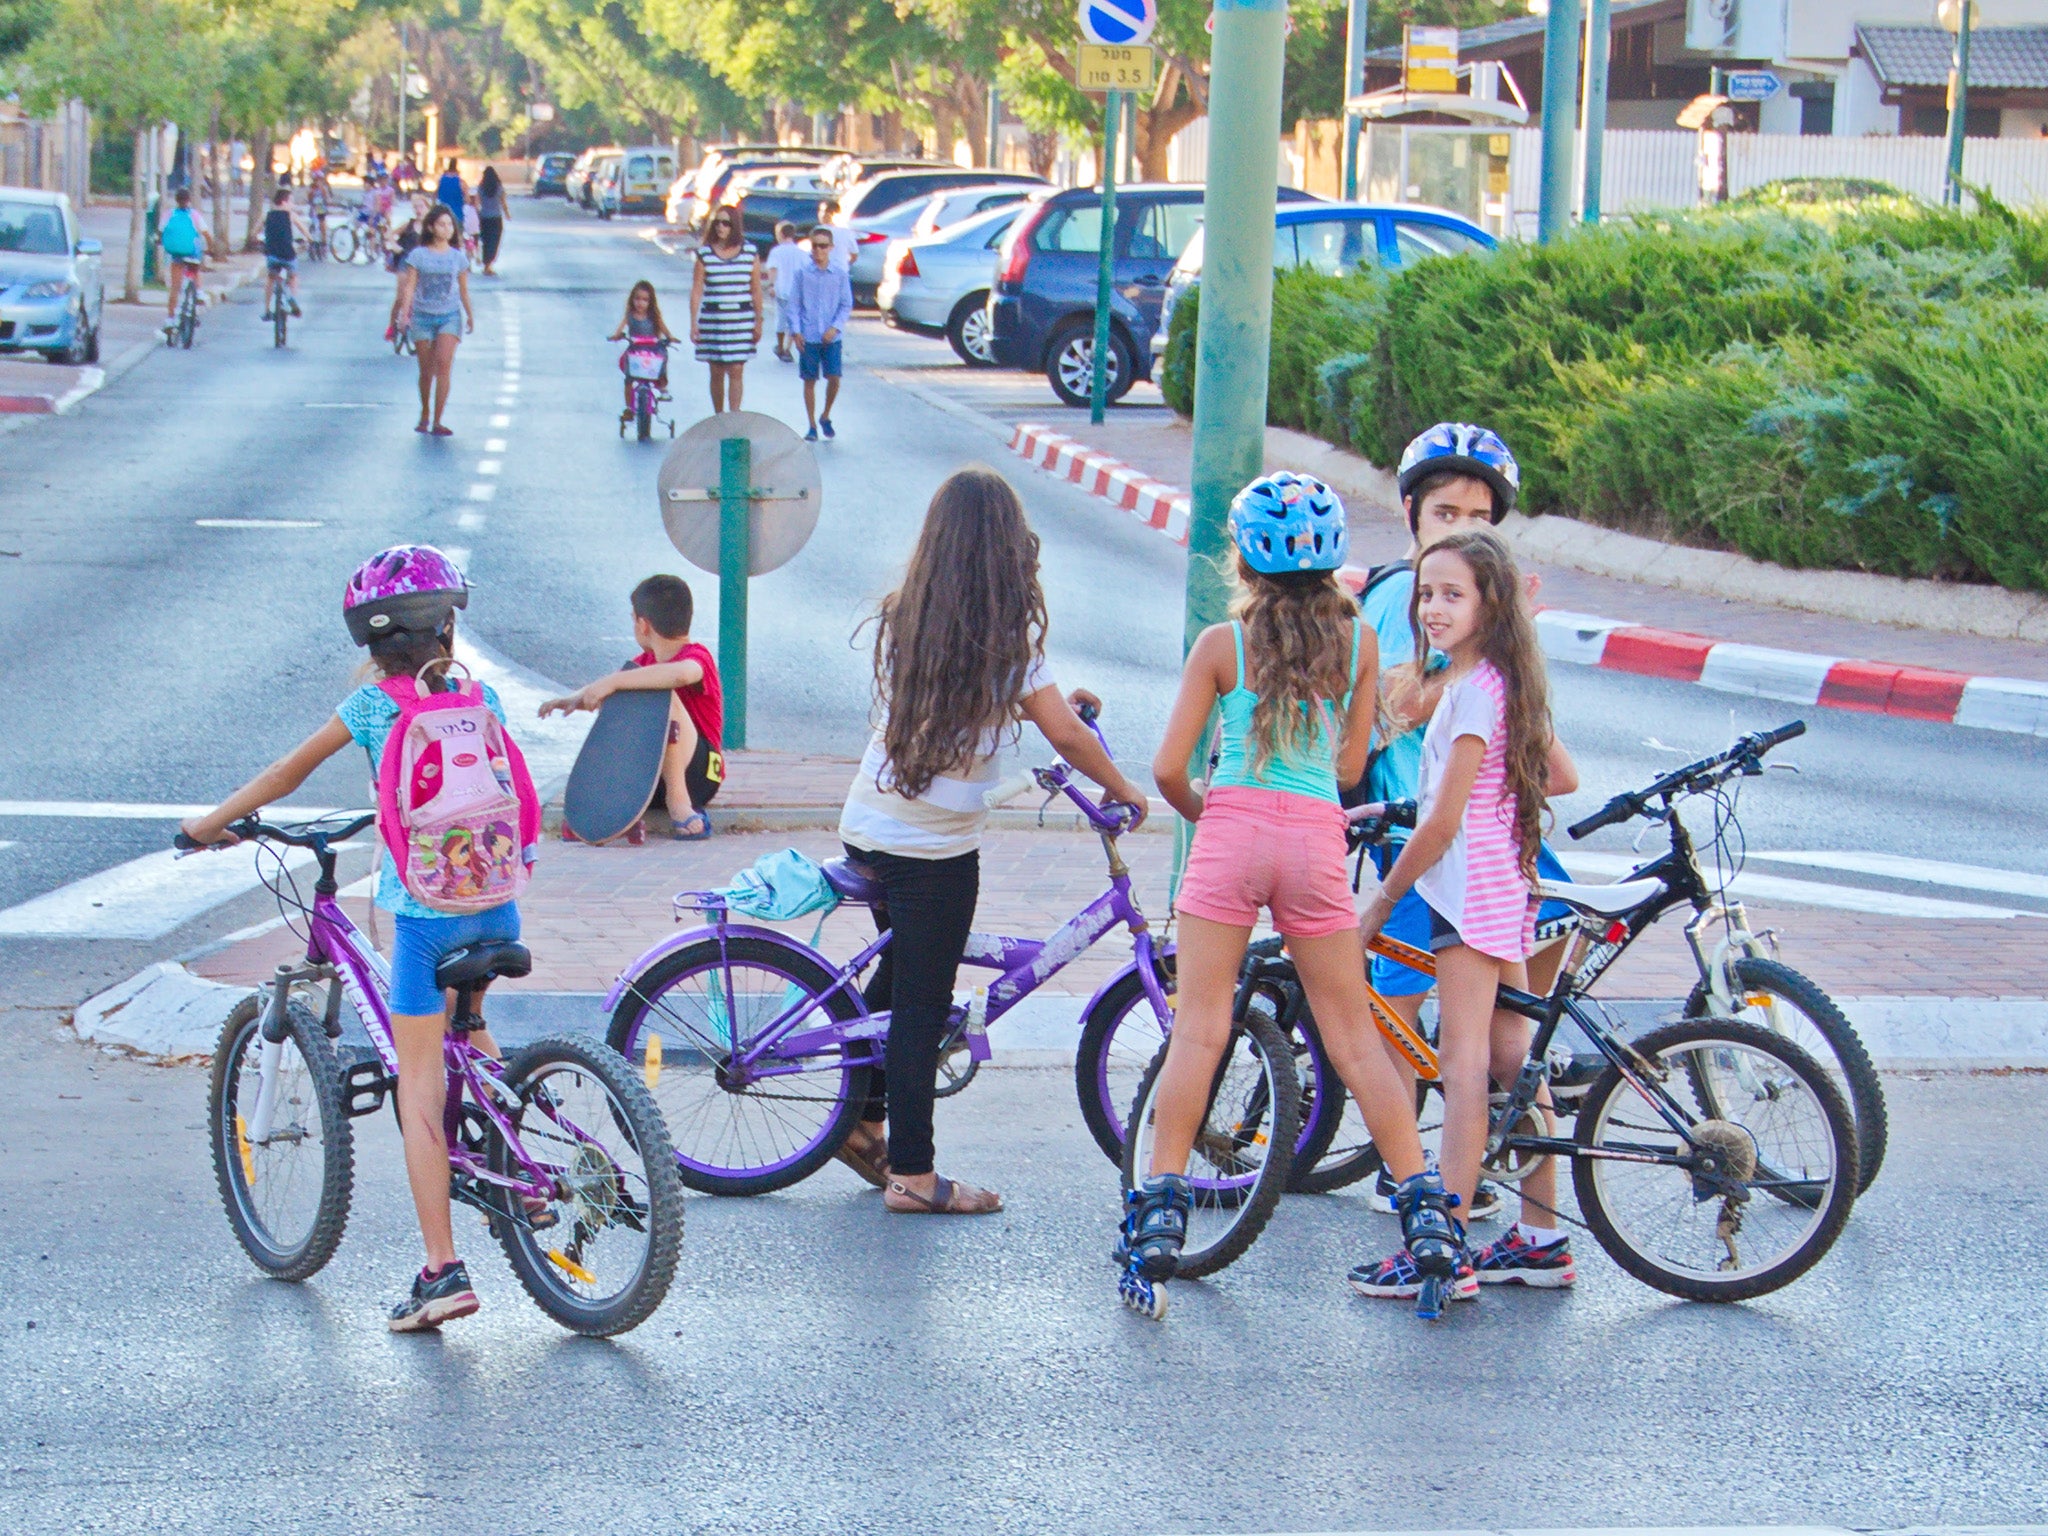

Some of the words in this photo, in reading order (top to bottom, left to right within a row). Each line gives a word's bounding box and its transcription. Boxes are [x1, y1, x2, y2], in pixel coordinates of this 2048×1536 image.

[1100, 47, 1132, 61] מעל
[1117, 68, 1141, 84] 3.5
[334, 961, 399, 1067] MERIDA
[1369, 1001, 1430, 1067] VISION
